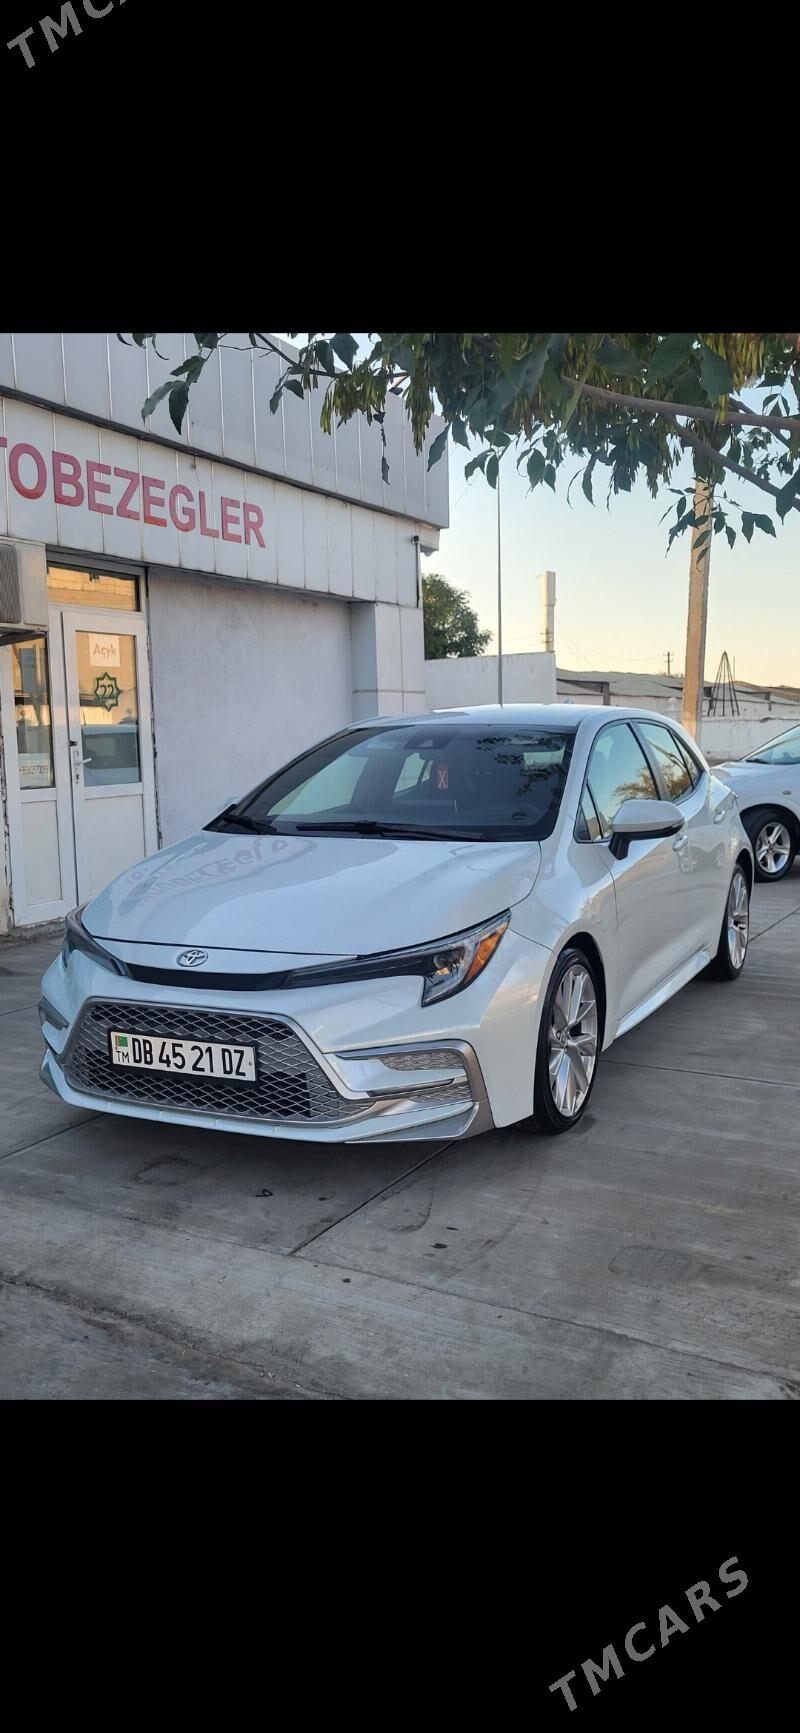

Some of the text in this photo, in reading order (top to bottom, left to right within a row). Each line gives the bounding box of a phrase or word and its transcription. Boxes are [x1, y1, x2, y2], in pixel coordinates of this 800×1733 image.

[0, 437, 266, 548] OBEZEGLER
[116, 1037, 246, 1077] TM DB 45 21 DZ
